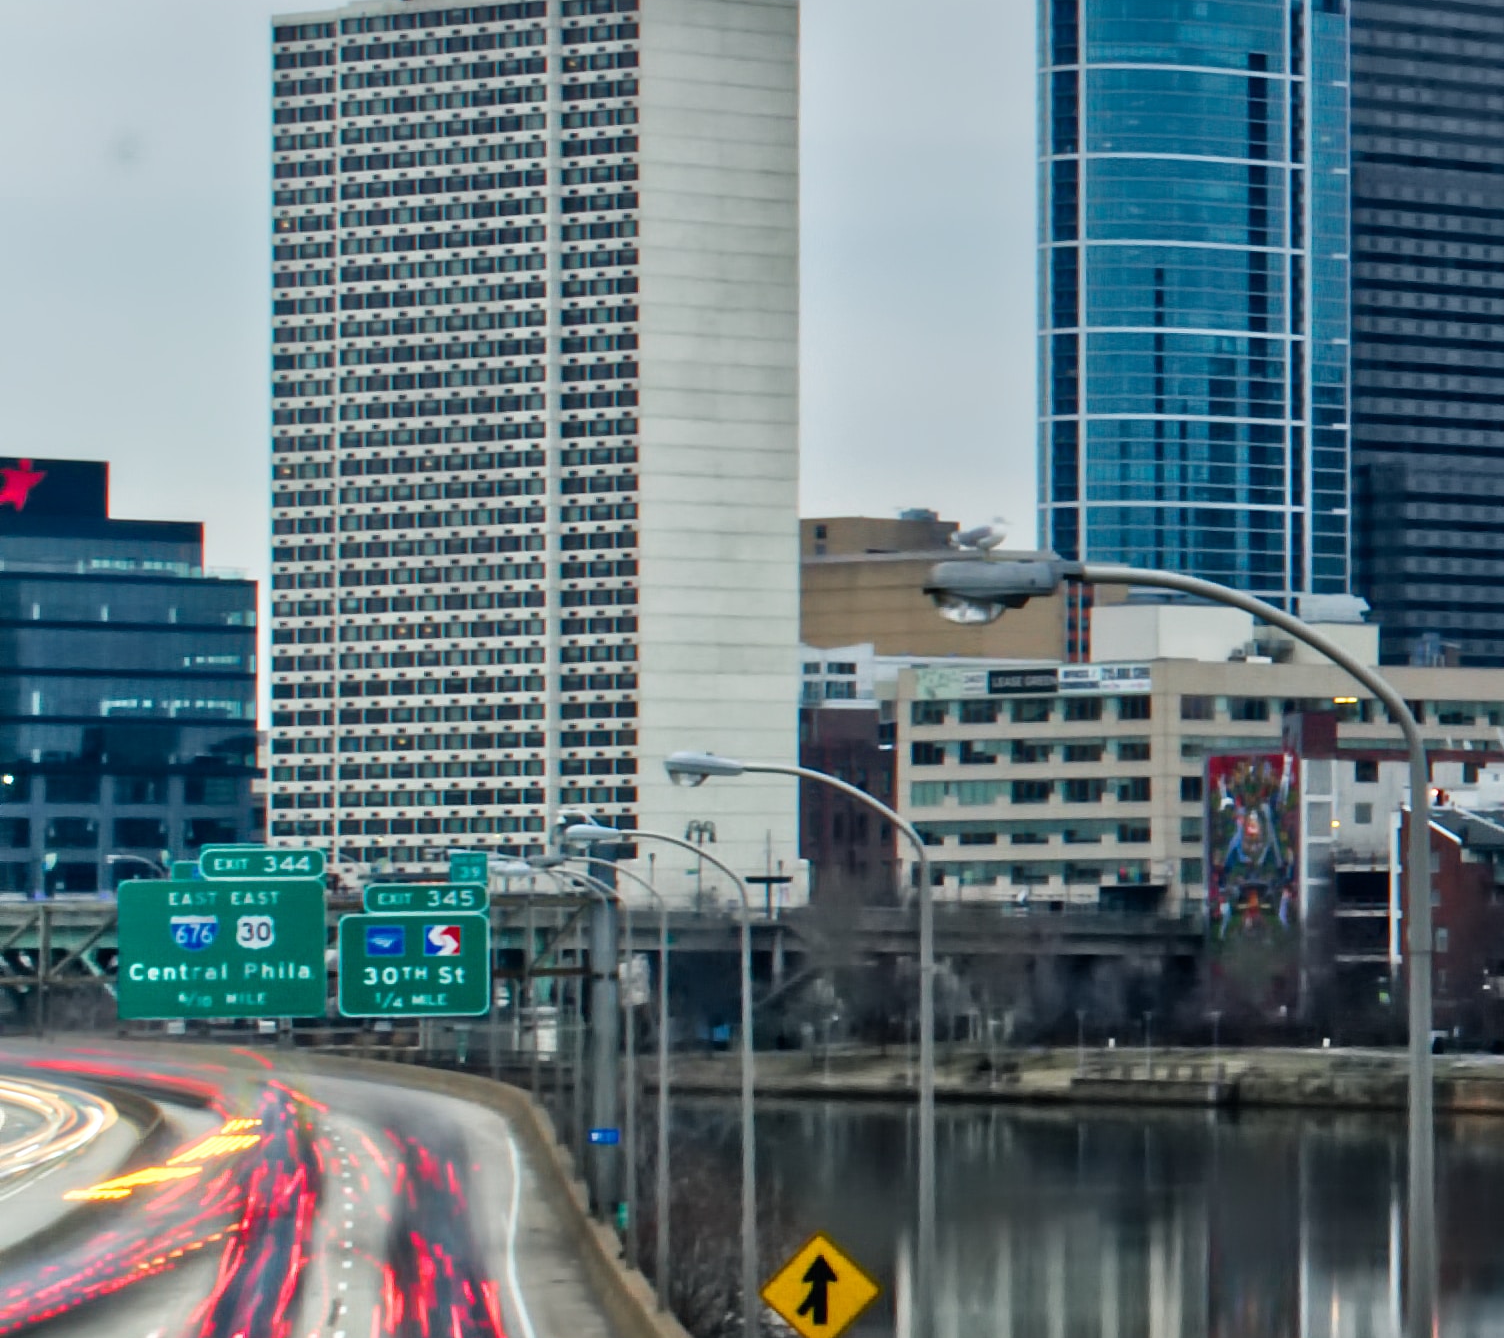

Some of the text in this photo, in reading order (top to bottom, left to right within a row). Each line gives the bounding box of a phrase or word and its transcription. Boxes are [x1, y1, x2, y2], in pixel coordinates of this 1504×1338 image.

[214, 856, 311, 872] EXIT 344
[168, 891, 280, 905] EAST EAST
[377, 890, 475, 907] EXIT 345
[175, 922, 271, 944] 676 30
[129, 963, 228, 981] Central
[363, 966, 465, 985] 30TH St
[225, 992, 267, 1006] MILE
[411, 993, 448, 1006] MILE
